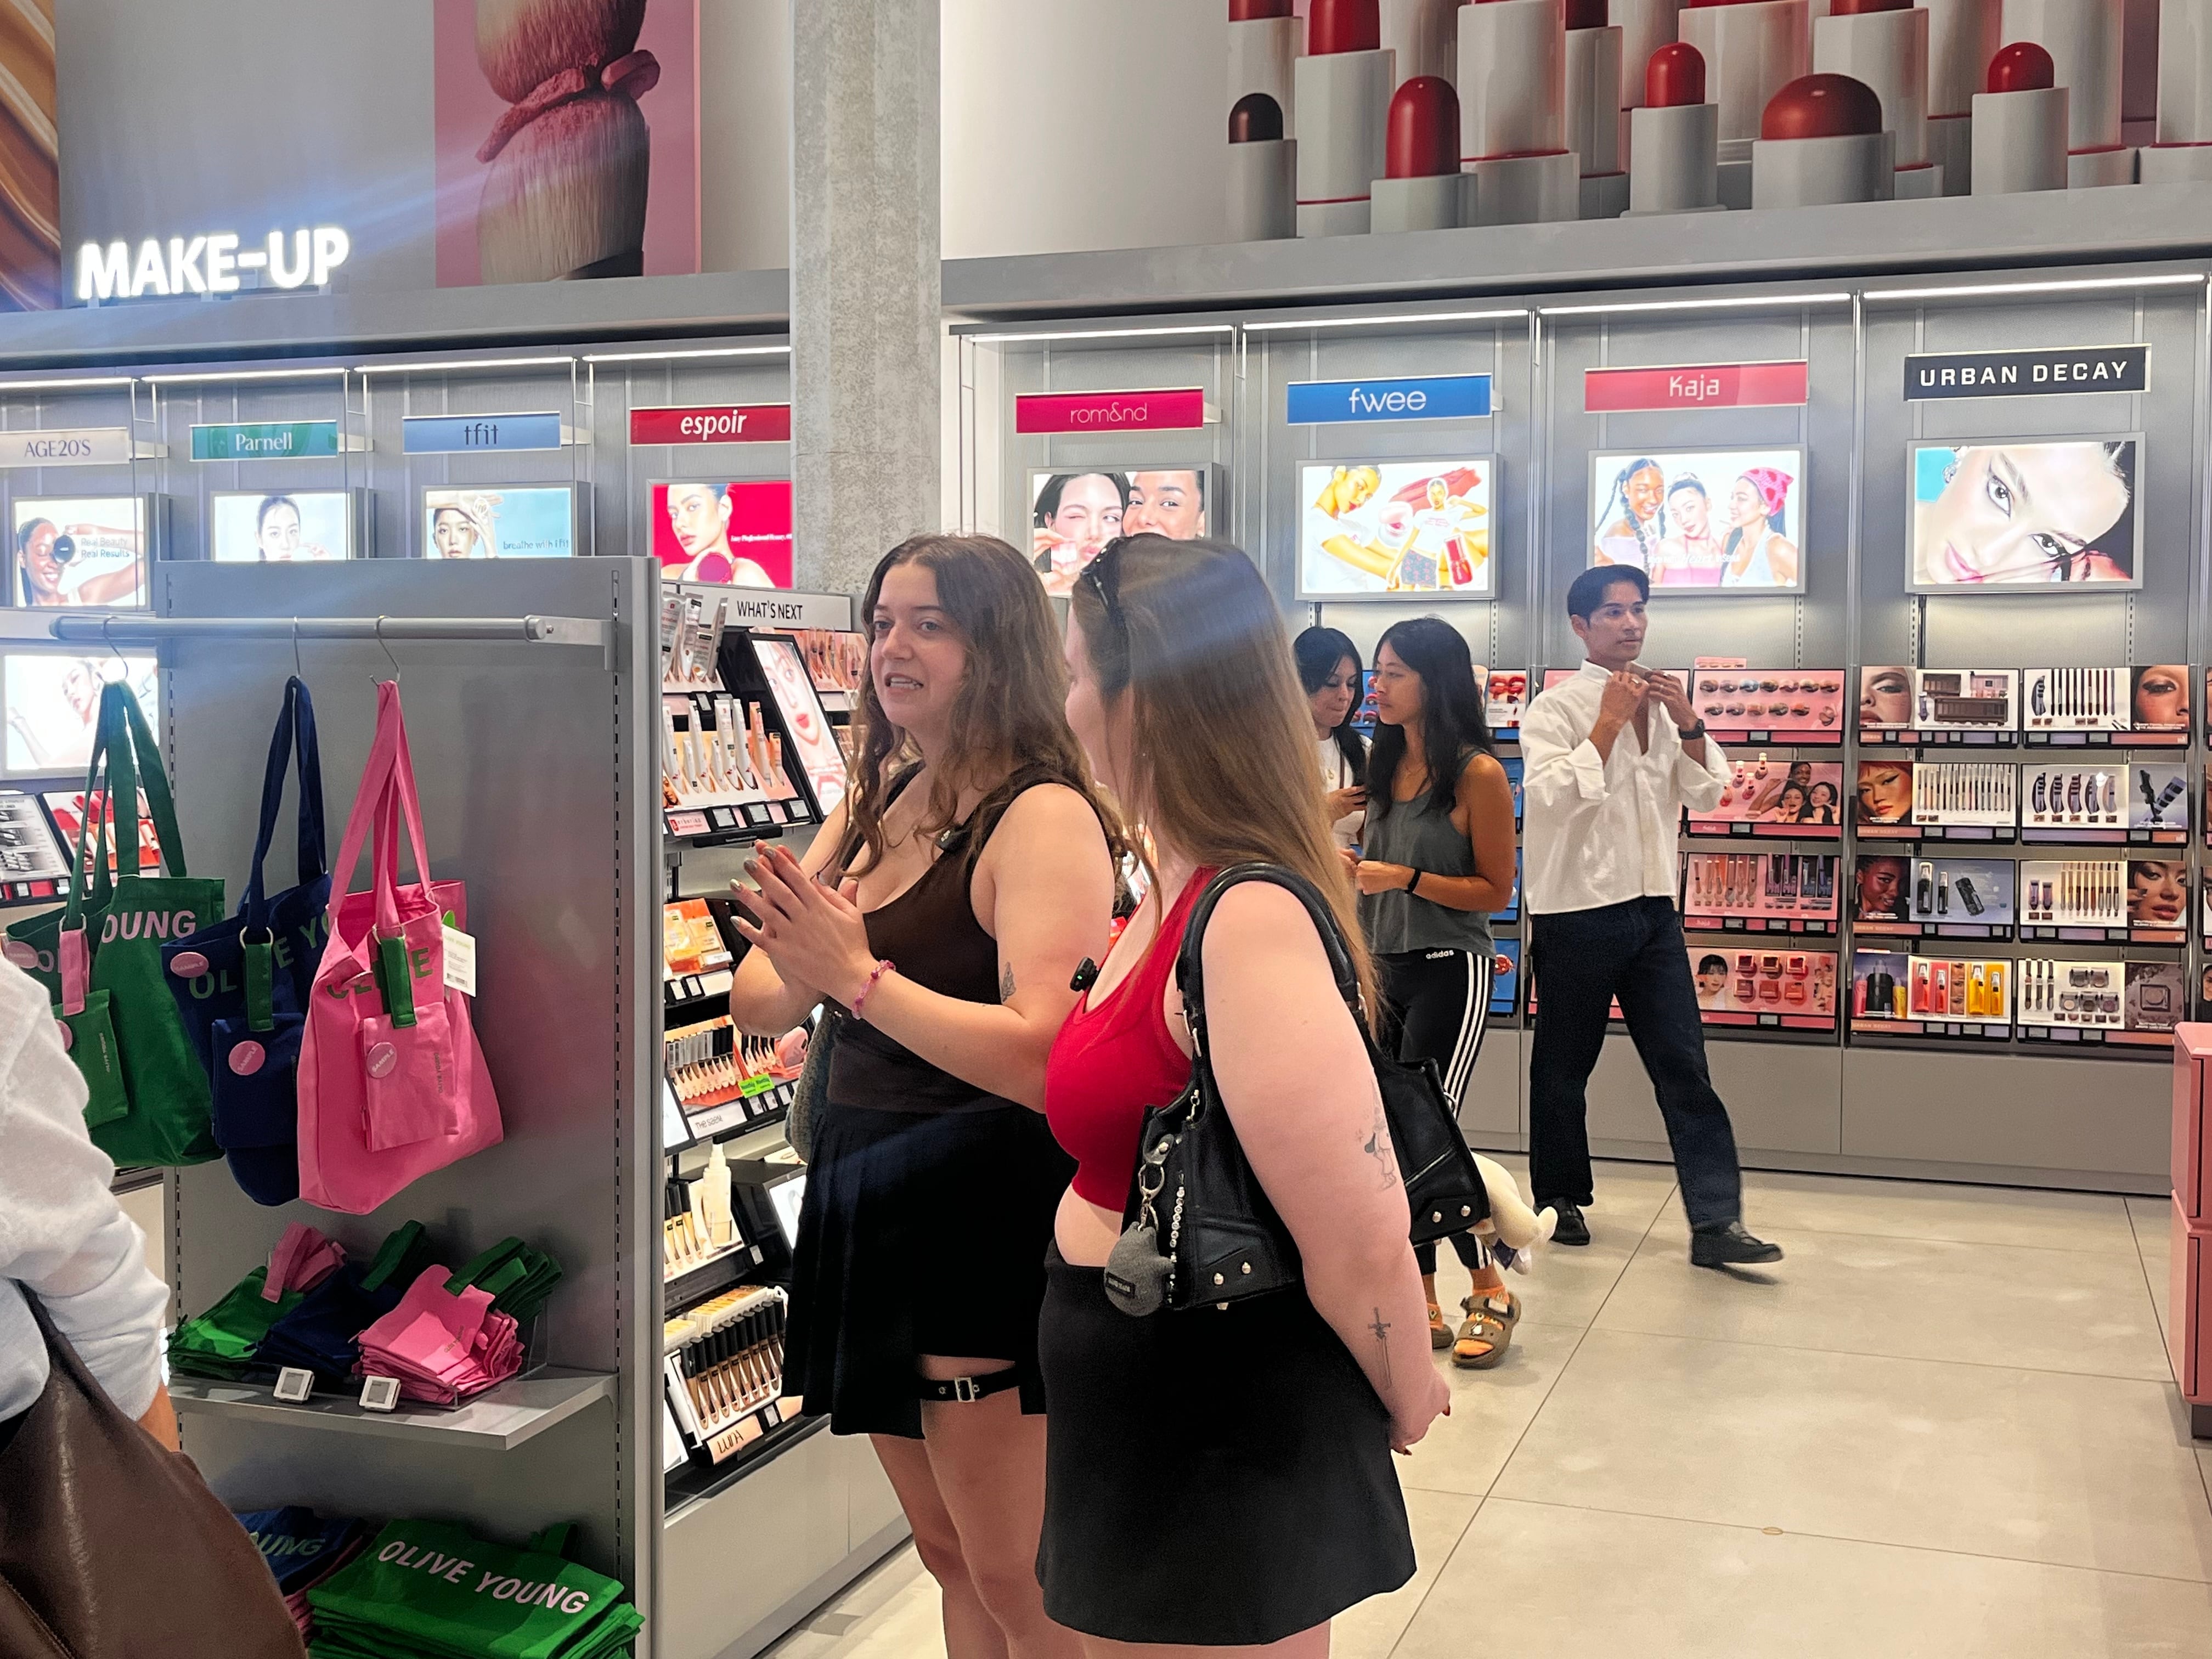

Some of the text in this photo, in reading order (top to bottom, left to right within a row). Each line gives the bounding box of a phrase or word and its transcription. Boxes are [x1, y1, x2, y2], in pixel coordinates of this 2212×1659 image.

[78, 228, 349, 300] MAKE-UP
[1919, 360, 2128, 387] URBAN DECAY
[1668, 374, 1720, 402] Kaja
[1070, 402, 1147, 424] rom&nd
[1348, 388, 1427, 414] fwee
[464, 423, 499, 445] tfit
[680, 409, 748, 441] espoir
[24, 439, 91, 459] AGE20'S
[235, 432, 293, 451] Parnell
[81, 537, 127, 549] Real Beauty
[81, 549, 130, 558] Real Results
[503, 541, 533, 549] breathe
[535, 539, 553, 549] with
[737, 600, 803, 620] WHAT'S NEXT
[101, 910, 196, 944] OUNG
[1426, 950, 1454, 960] adidas
[372, 1048, 394, 1073] SAMPLE
[716, 1429, 744, 1454] LUNA
[250, 1531, 326, 1556] UNG
[378, 1541, 590, 1613] OLIVE YOUNG
